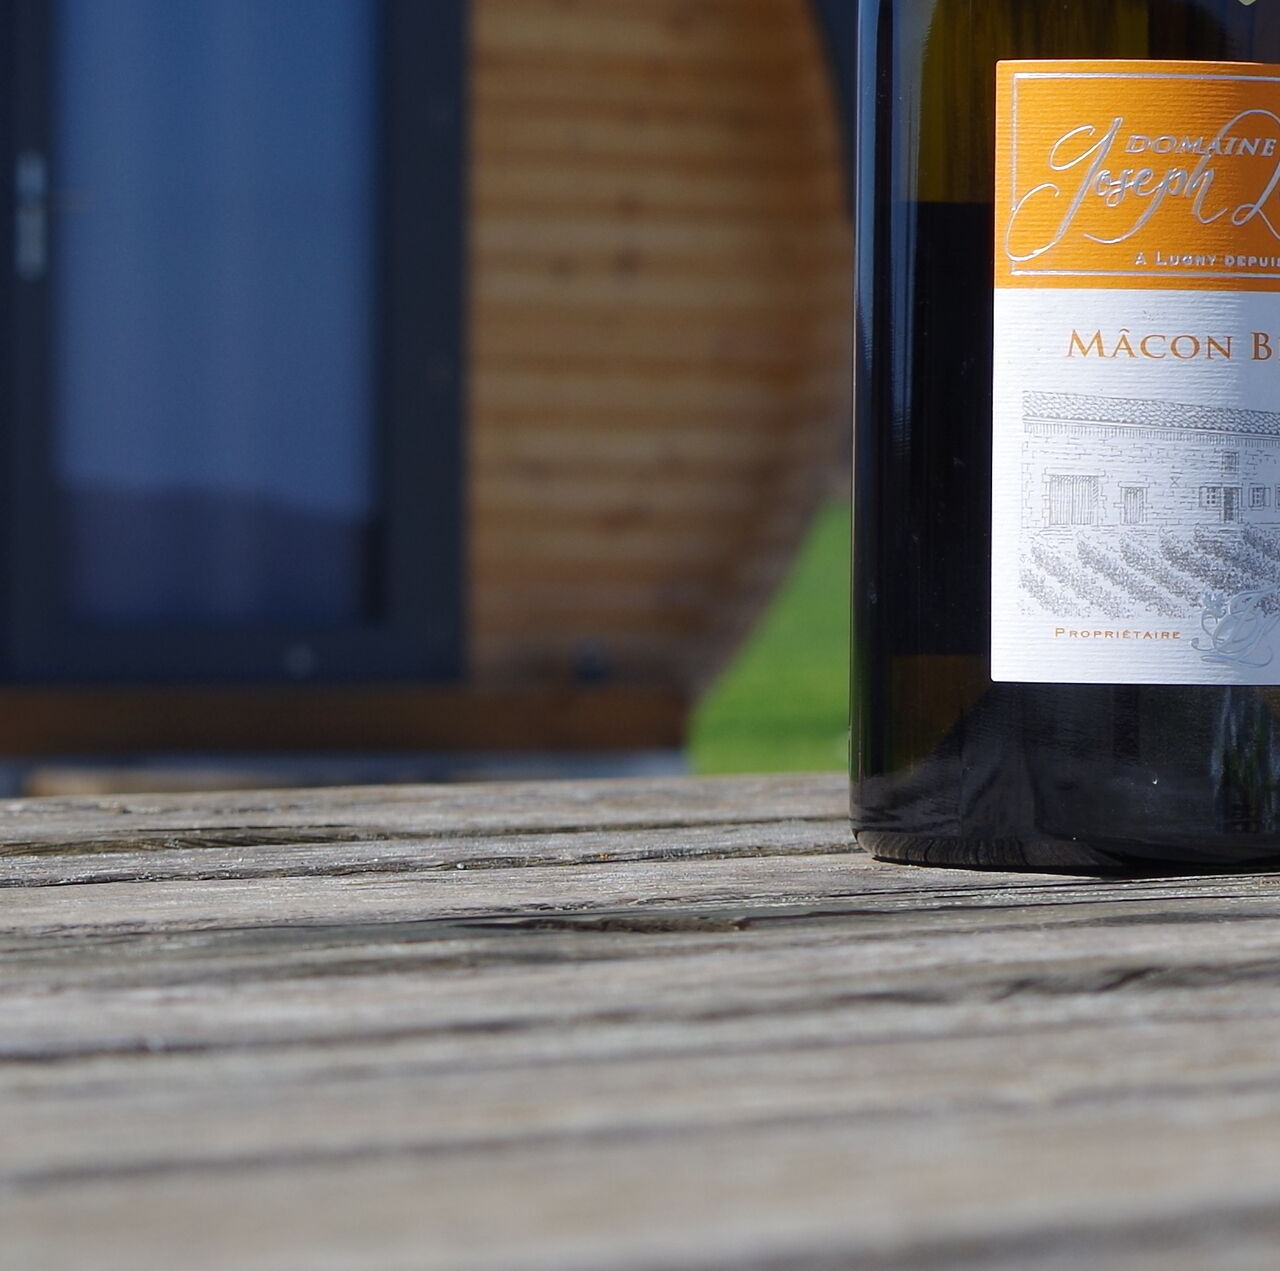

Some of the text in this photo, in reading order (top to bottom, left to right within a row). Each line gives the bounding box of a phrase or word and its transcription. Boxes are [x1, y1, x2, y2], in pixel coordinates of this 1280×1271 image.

[1125, 134, 1278, 158] DOMAINE
[1155, 251, 1217, 267] LUGNY
[1065, 328, 1233, 361] MÂCON
[1054, 625, 1181, 640] PROPRIÉTAIRE
